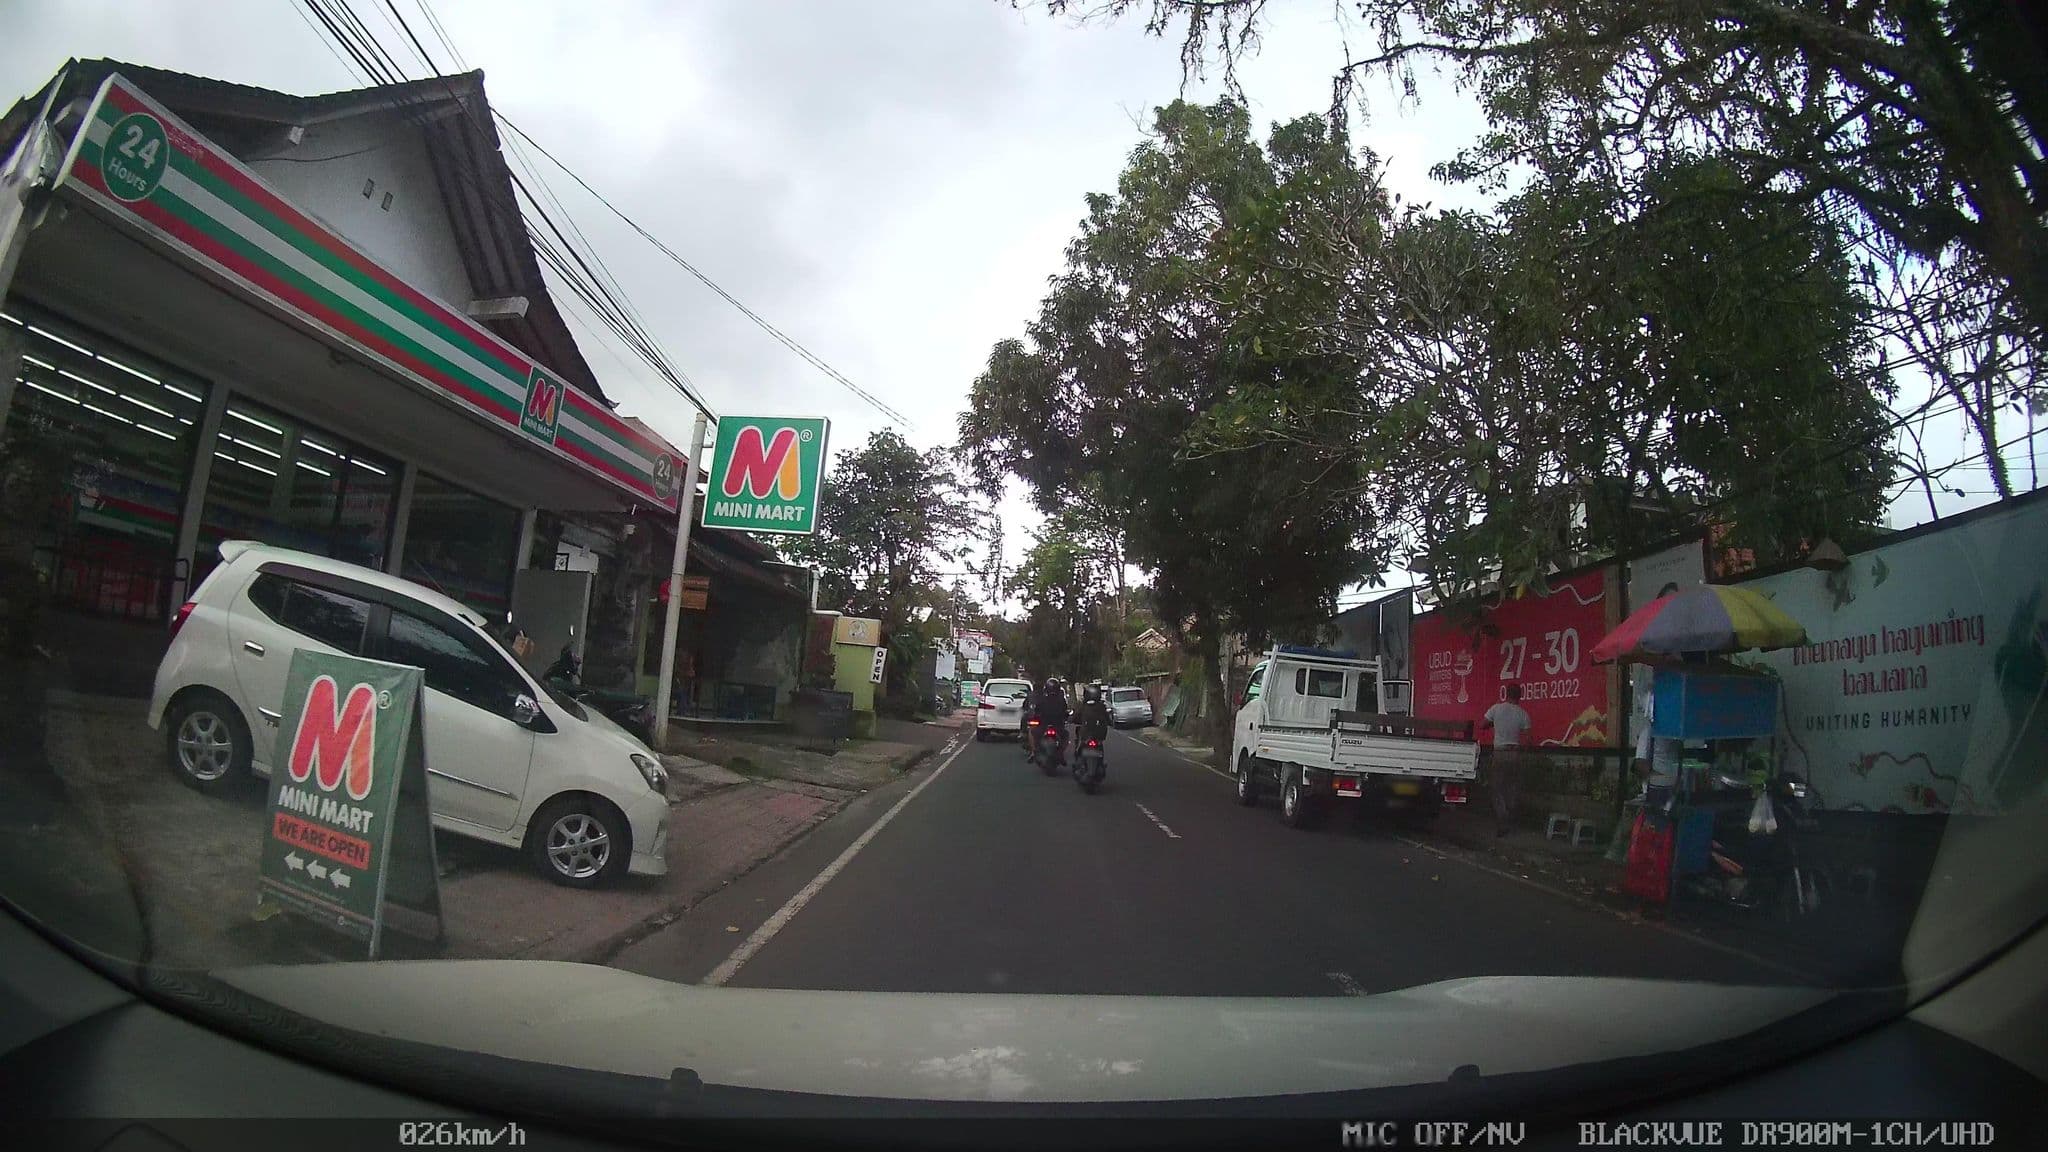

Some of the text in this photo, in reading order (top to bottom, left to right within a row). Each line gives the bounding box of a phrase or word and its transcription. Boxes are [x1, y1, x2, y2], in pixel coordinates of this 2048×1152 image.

[119, 125, 161, 169] 24
[657, 460, 671, 481] 24
[713, 501, 805, 521] MINI MART
[871, 650, 884, 681] OPEN
[1428, 651, 1452, 669] UBUD
[1500, 637, 1527, 680] 27
[1544, 628, 1579, 675] 30
[1500, 678, 1580, 701] OOBER 2022
[1806, 703, 1972, 731] UNITING HUMANITY
[278, 785, 374, 833] MINI MART
[278, 819, 366, 863] WE ARE OPEN
